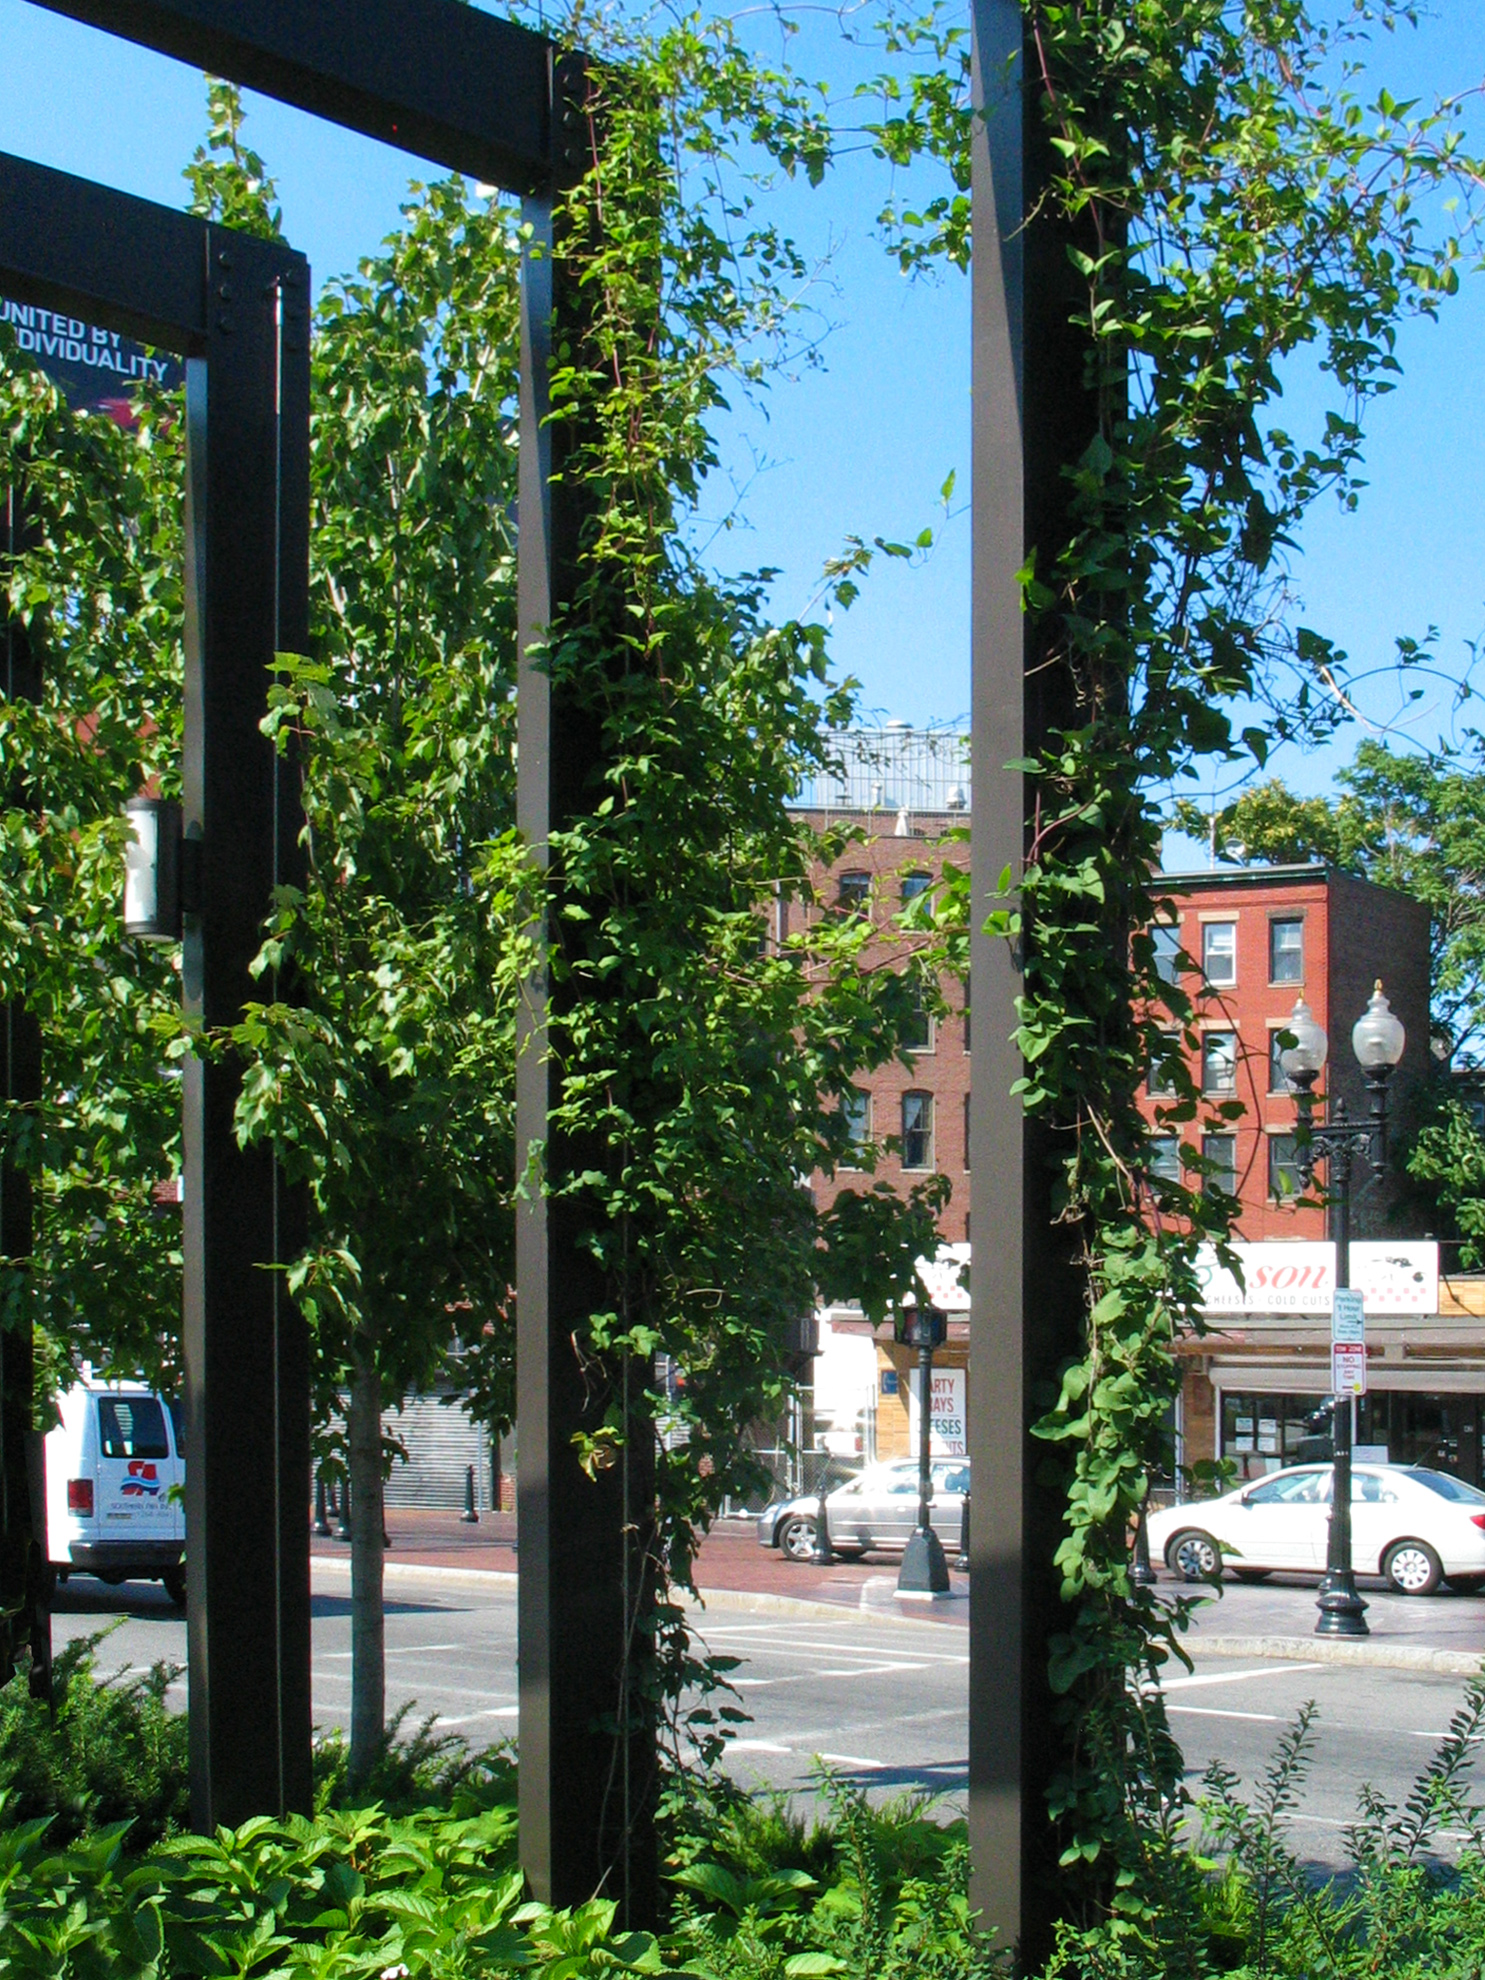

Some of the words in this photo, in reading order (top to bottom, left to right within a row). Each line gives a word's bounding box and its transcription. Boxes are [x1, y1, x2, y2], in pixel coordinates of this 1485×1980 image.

[0, 301, 86, 339] UNITED
[92, 326, 121, 349] BY
[14, 327, 168, 382] DIVIDUALITY
[1249, 1265, 1327, 1289] son
[1206, 1295, 1254, 1305] CHEESS
[1267, 1295, 1296, 1305] COLD
[1302, 1295, 1330, 1306] CUTS
[929, 1378, 955, 1394] ARTY
[929, 1396, 954, 1413] AYS
